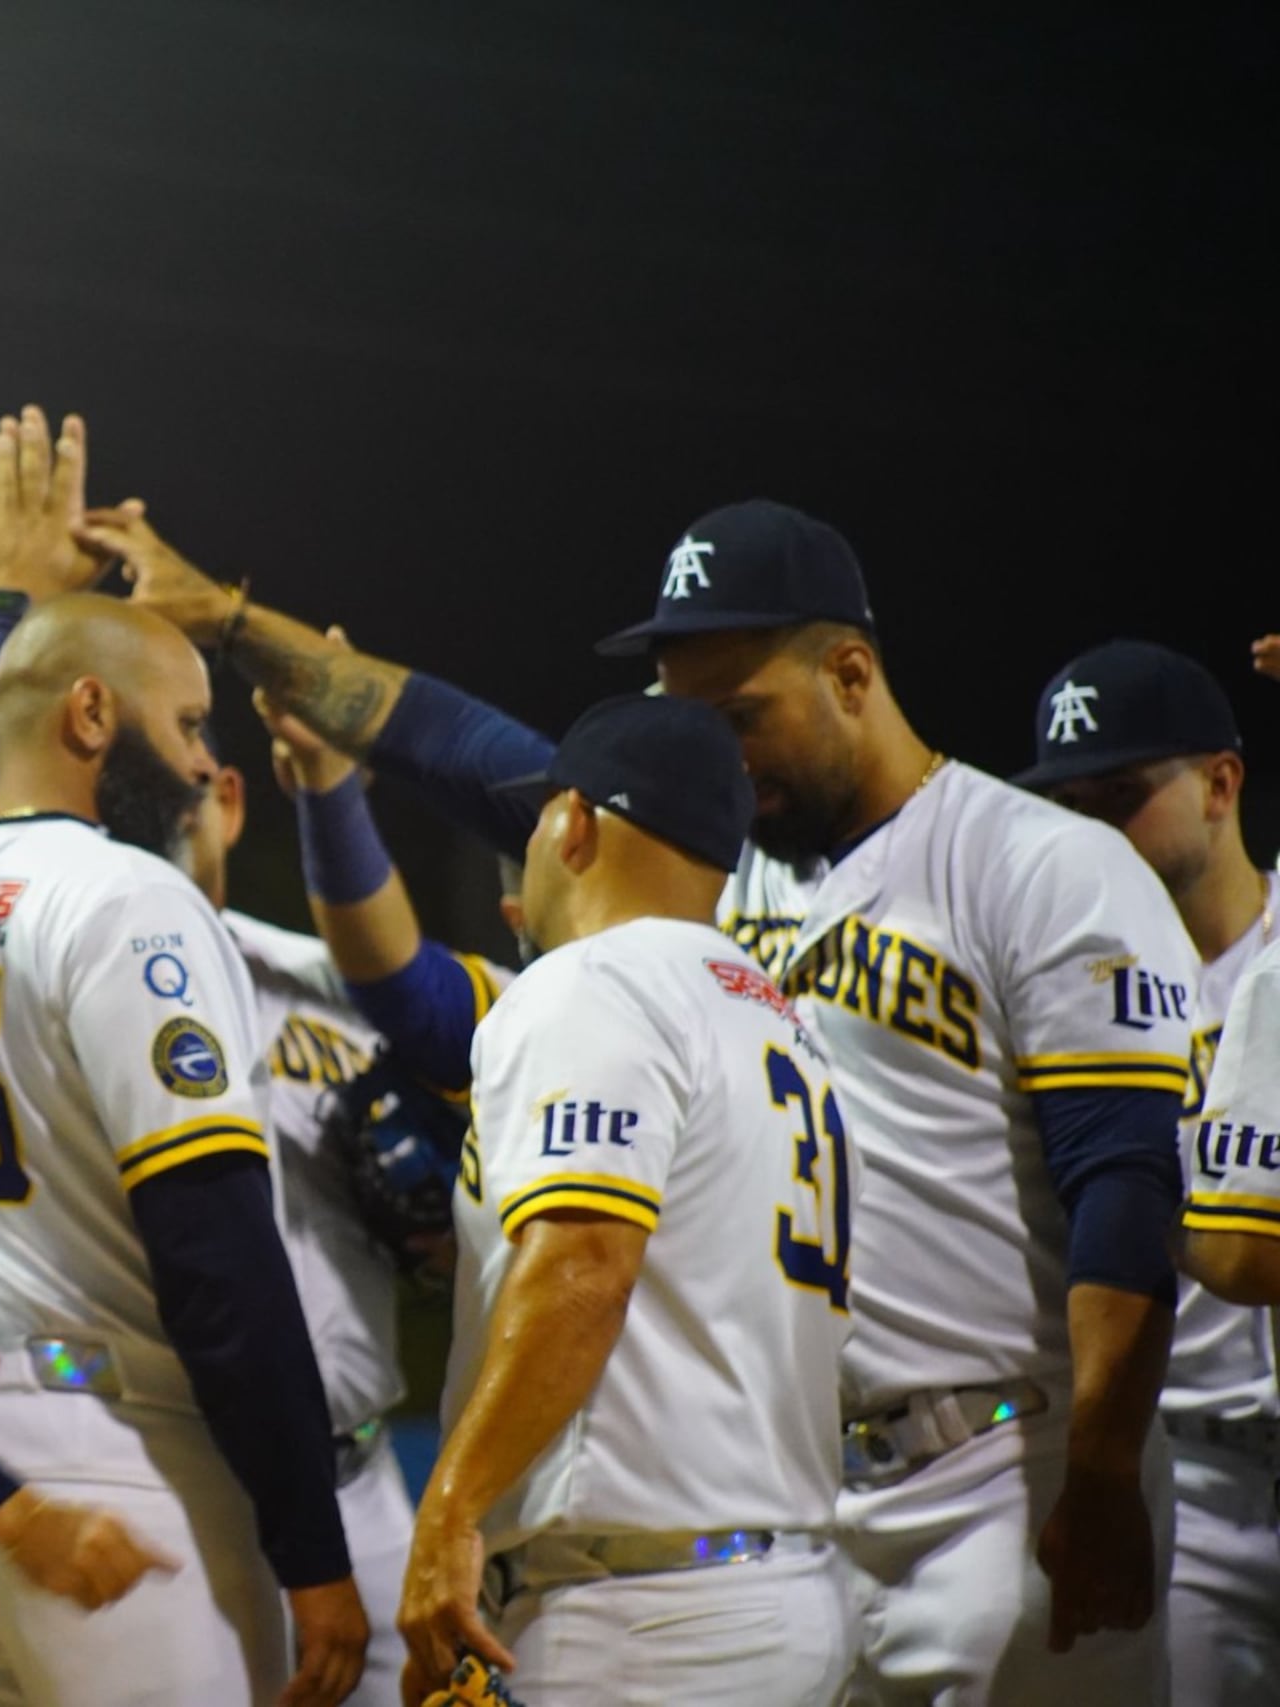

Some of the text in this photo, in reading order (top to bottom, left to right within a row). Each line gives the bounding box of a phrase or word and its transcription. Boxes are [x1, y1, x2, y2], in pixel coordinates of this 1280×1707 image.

[131, 933, 184, 954] DON
[144, 952, 193, 1008] Q
[1110, 967, 1187, 1032] Lite
[538, 1100, 638, 1158] Lite
[1196, 1120, 1280, 1180] Lite
[762, 1040, 851, 1318] 31
